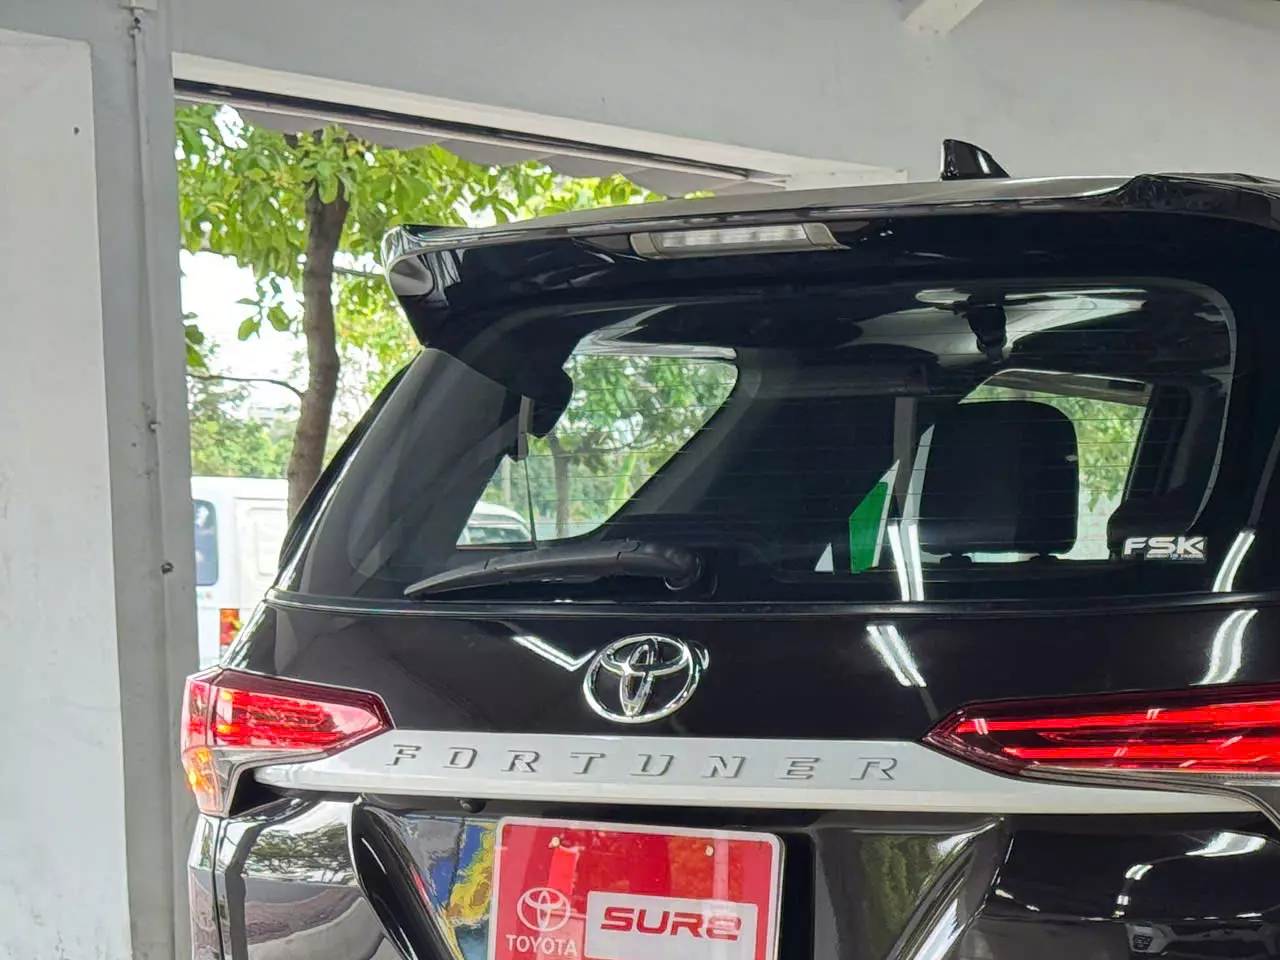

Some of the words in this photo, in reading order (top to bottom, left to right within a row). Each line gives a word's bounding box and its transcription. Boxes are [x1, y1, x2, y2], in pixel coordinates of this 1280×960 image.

[1124, 536, 1205, 556] FSK
[385, 743, 898, 781] FORTUNER
[505, 934, 577, 957] TOYOTA
